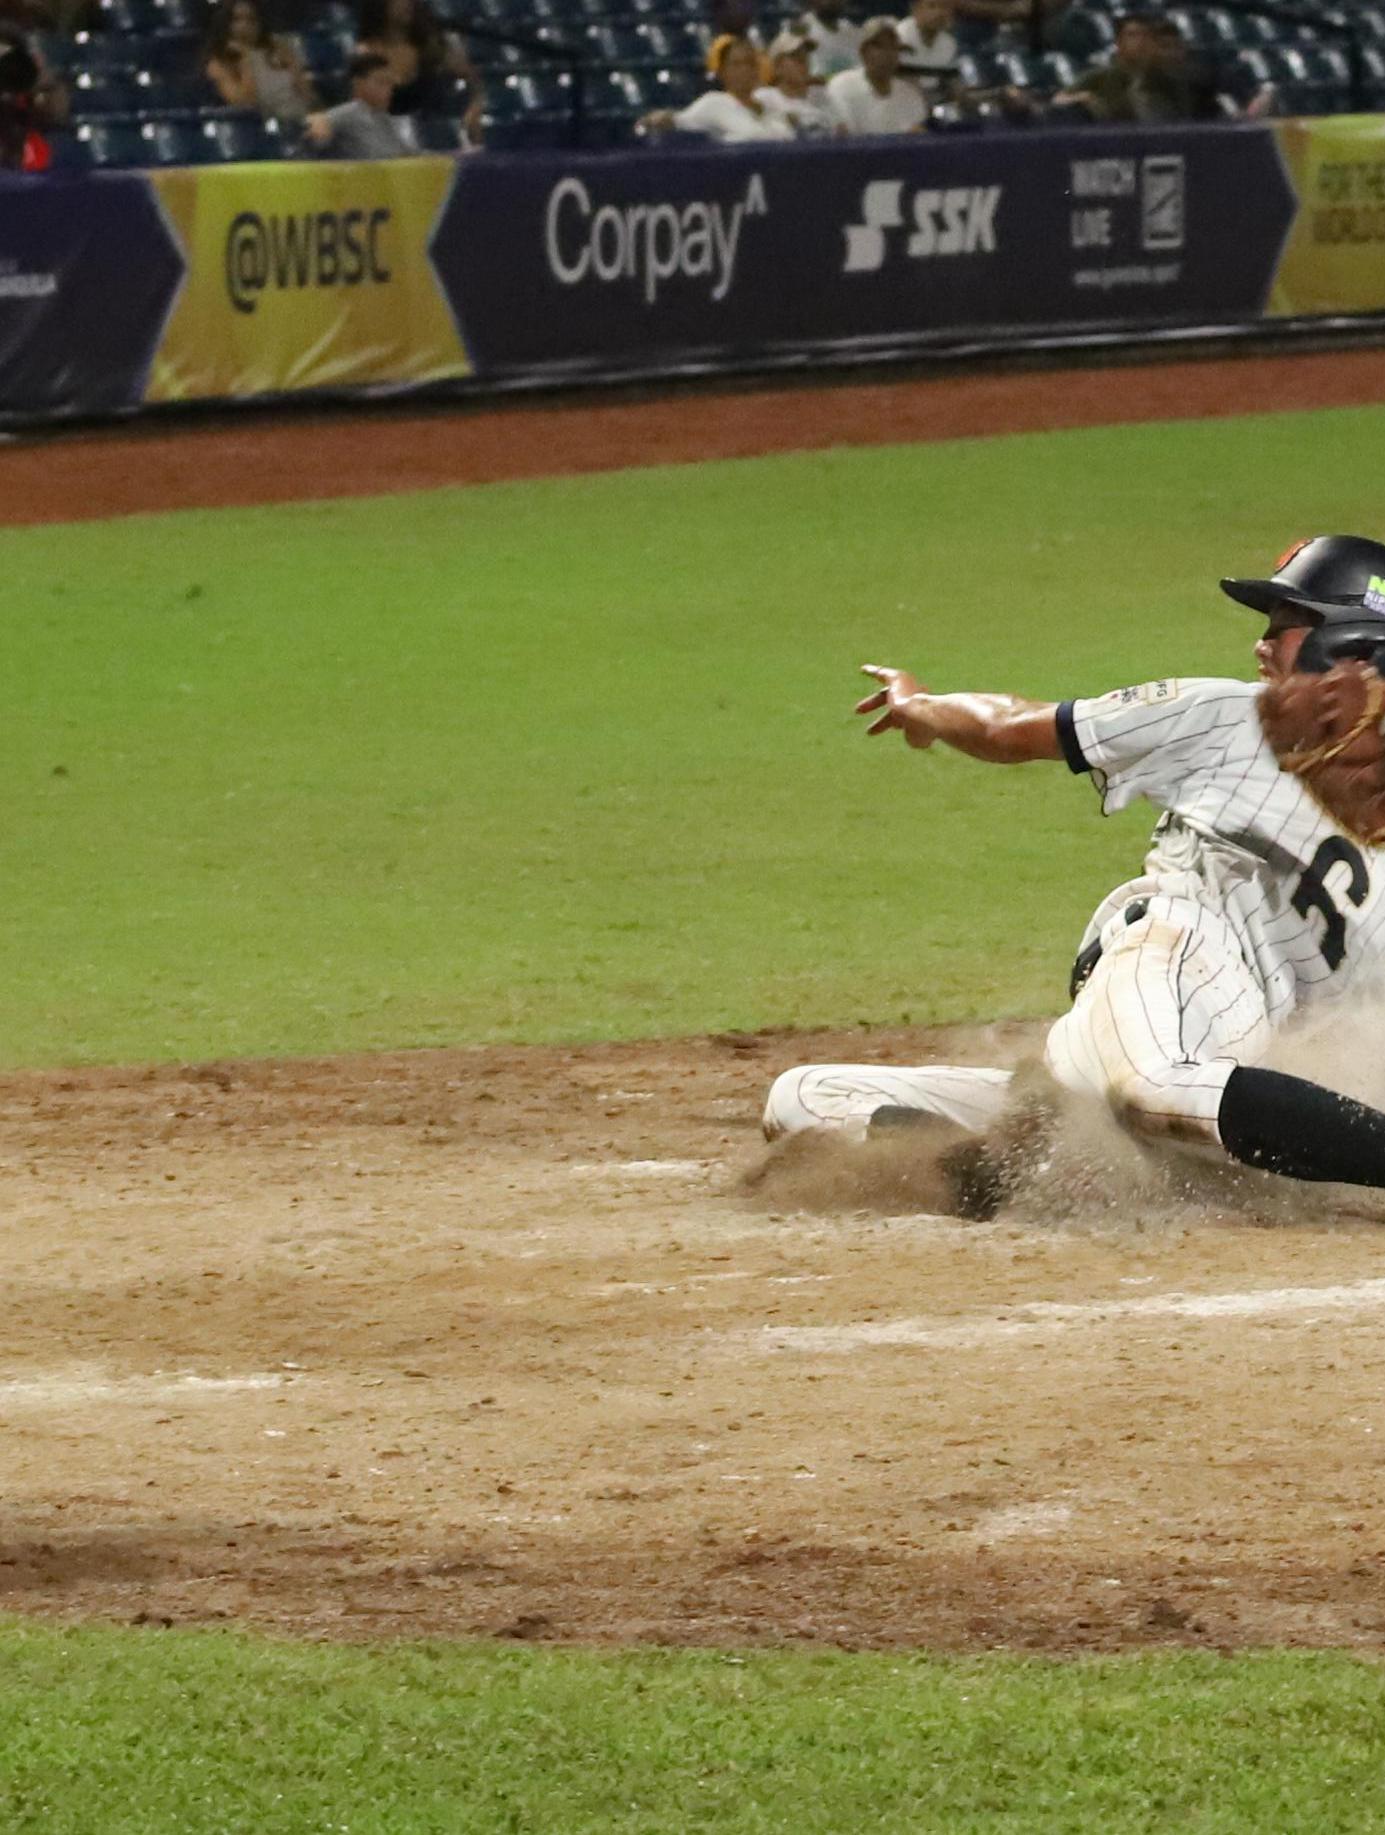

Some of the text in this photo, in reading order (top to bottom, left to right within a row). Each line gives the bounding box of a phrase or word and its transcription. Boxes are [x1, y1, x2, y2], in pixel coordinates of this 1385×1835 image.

[226, 208, 391, 314] @WBSC
[546, 177, 745, 303] Corpay
[907, 186, 1001, 258] SSK
